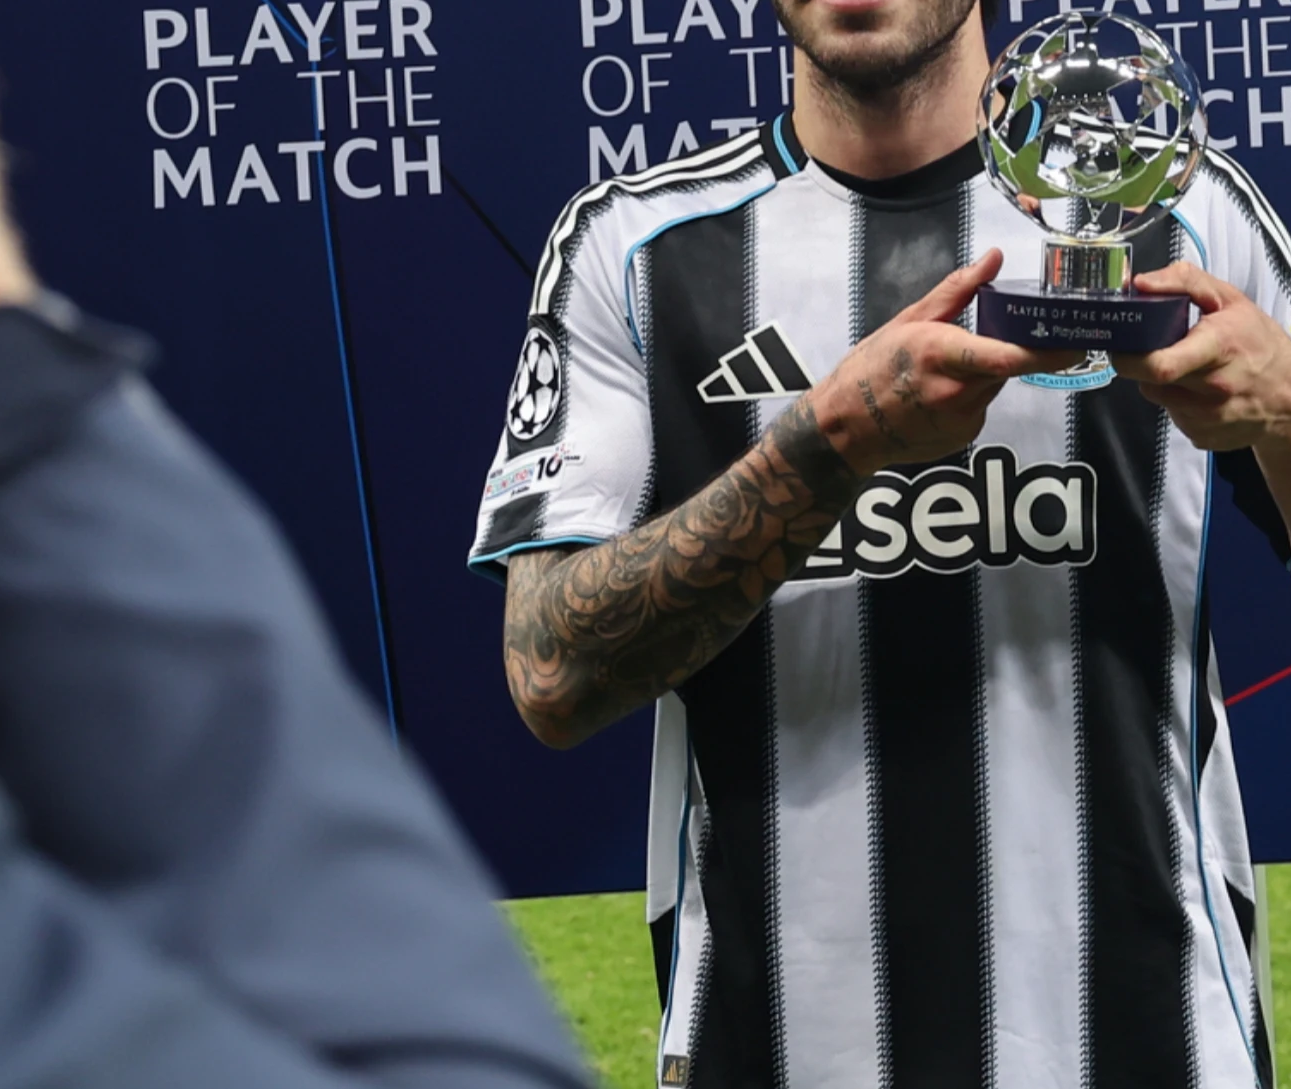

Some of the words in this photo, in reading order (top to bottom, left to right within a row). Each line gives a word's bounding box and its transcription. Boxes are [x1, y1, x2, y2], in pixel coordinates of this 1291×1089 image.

[146, 75, 239, 140] OF
[296, 65, 441, 132] THE
[581, 52, 673, 117] OF
[153, 135, 443, 209] MATCH
[1006, 303, 1047, 318] PLAYER
[1051, 308, 1067, 319] OF
[1073, 309, 1096, 321] THE
[1101, 311, 1143, 323] MATCH
[1052, 325, 1112, 342] PlayStation
[854, 458, 1084, 564] sela
